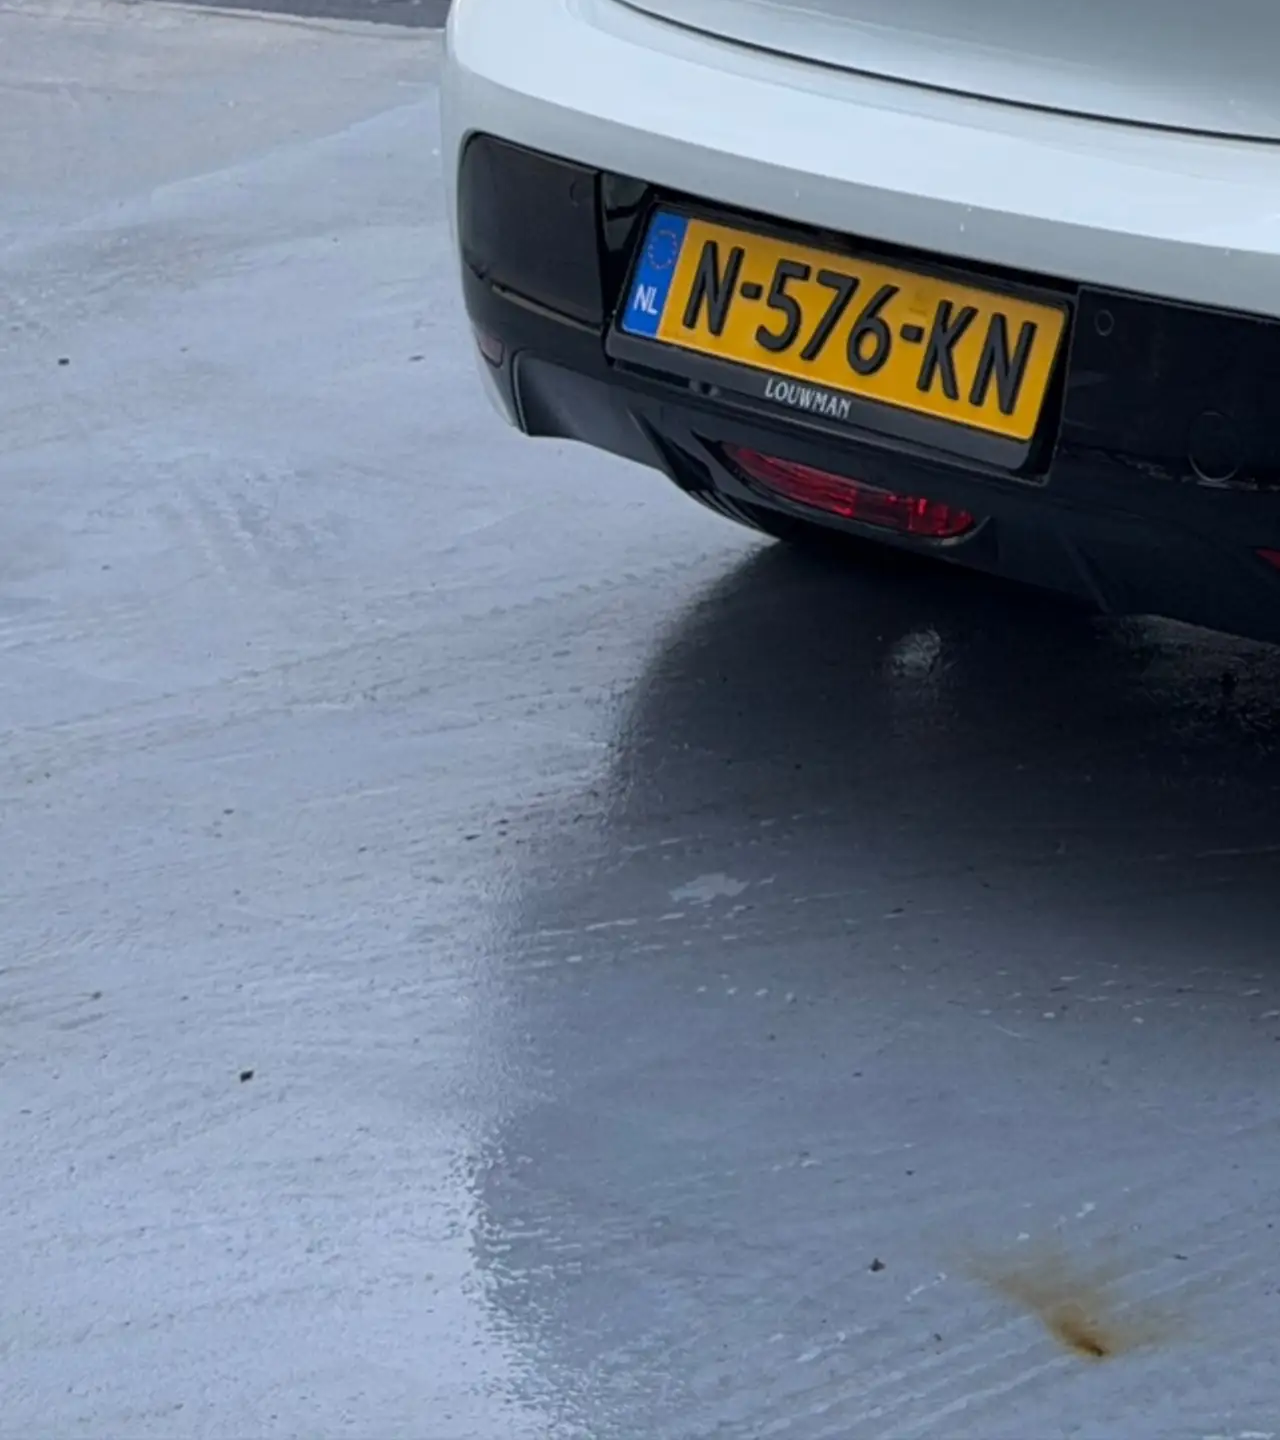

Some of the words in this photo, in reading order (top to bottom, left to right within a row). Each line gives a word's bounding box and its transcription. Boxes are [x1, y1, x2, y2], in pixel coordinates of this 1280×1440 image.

[633, 283, 659, 316] NL
[682, 239, 1038, 416] N-576-KN
[764, 377, 851, 420] LOUWMAN
